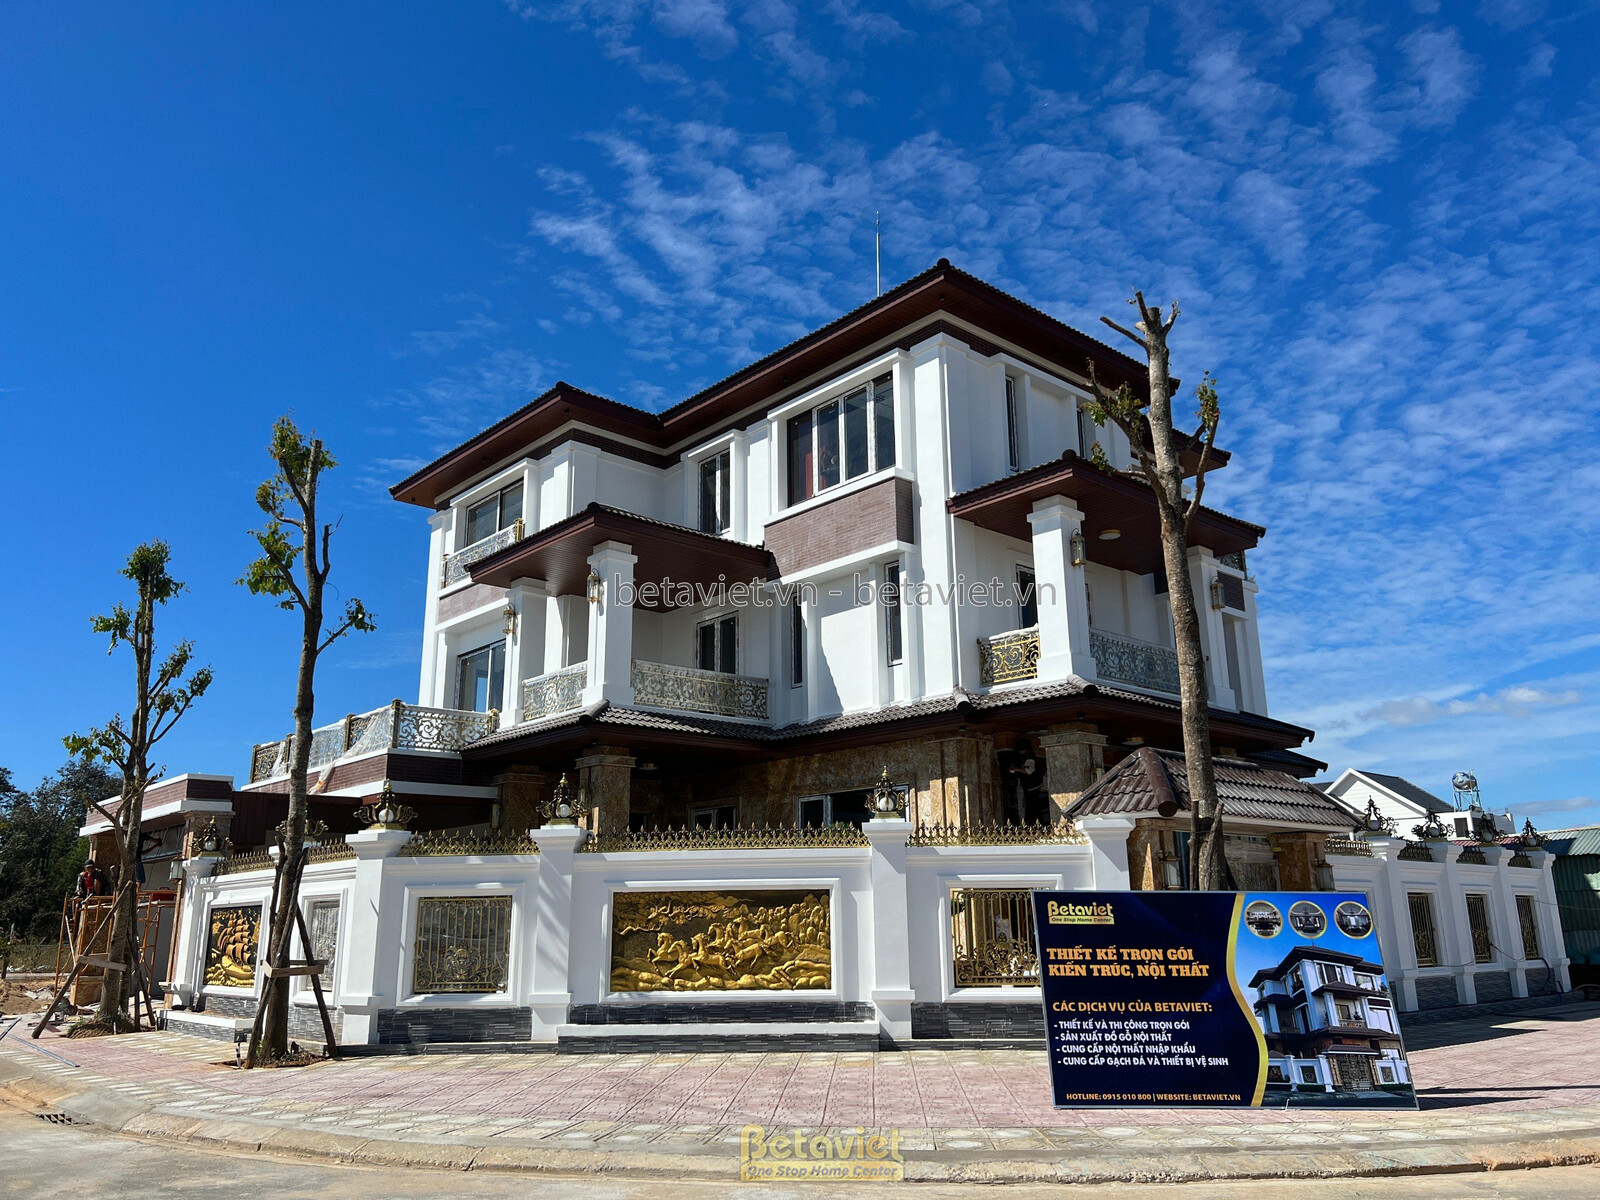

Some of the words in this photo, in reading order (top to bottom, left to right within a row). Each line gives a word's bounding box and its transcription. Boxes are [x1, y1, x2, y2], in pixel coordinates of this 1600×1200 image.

[1048, 901, 1113, 917] Betaviet
[1046, 945, 1092, 960] THIẾT
[1096, 945, 1117, 960] KẾ
[1120, 949, 1163, 963] TRỌN
[1167, 947, 1194, 960] GÓI
[1048, 961, 1086, 976] KIẾN
[1090, 963, 1133, 978] TRÚC,
[1137, 962, 1166, 979] NỘI
[1169, 961, 1209, 976] THẤT
[1052, 1001, 1075, 1011] CÁC
[1079, 1002, 1106, 1014] DỊCH
[1109, 1002, 1126, 1014] VỤ
[1128, 1000, 1152, 1012] CỦA
[1155, 1002, 1212, 1012] BETAVIET:
[1059, 1018, 1081, 1029] THIẾT
[1083, 1018, 1093, 1029] KẾ
[1094, 1020, 1107, 1029] VÀ
[1124, 1020, 1148, 1029] CÔNG
[1149, 1022, 1172, 1031] TRỌN
[1174, 1020, 1189, 1029] GÓI
[1060, 1031, 1078, 1041] SẢN
[1080, 1030, 1101, 1041] XUẤT
[1134, 1032, 1149, 1043] NỘI
[1150, 1030, 1171, 1041] THẤT
[1062, 1045, 1085, 1053] CUNG
[1087, 1042, 1104, 1053] CẤP
[1106, 1044, 1120, 1055] NỘI
[1122, 1042, 1144, 1053] THẤT
[1146, 1044, 1169, 1055] NHẬP
[1171, 1042, 1195, 1053] KHẨU
[1063, 1057, 1087, 1065] CUNG
[1089, 1054, 1105, 1065] CẤP
[1107, 1057, 1131, 1067] GẠCH
[1133, 1056, 1146, 1065] ĐÁ
[1147, 1056, 1160, 1065] VÀ
[1162, 1054, 1184, 1065] THIẾT
[1186, 1058, 1194, 1067] BỊ
[1195, 1055, 1207, 1067] VỆ
